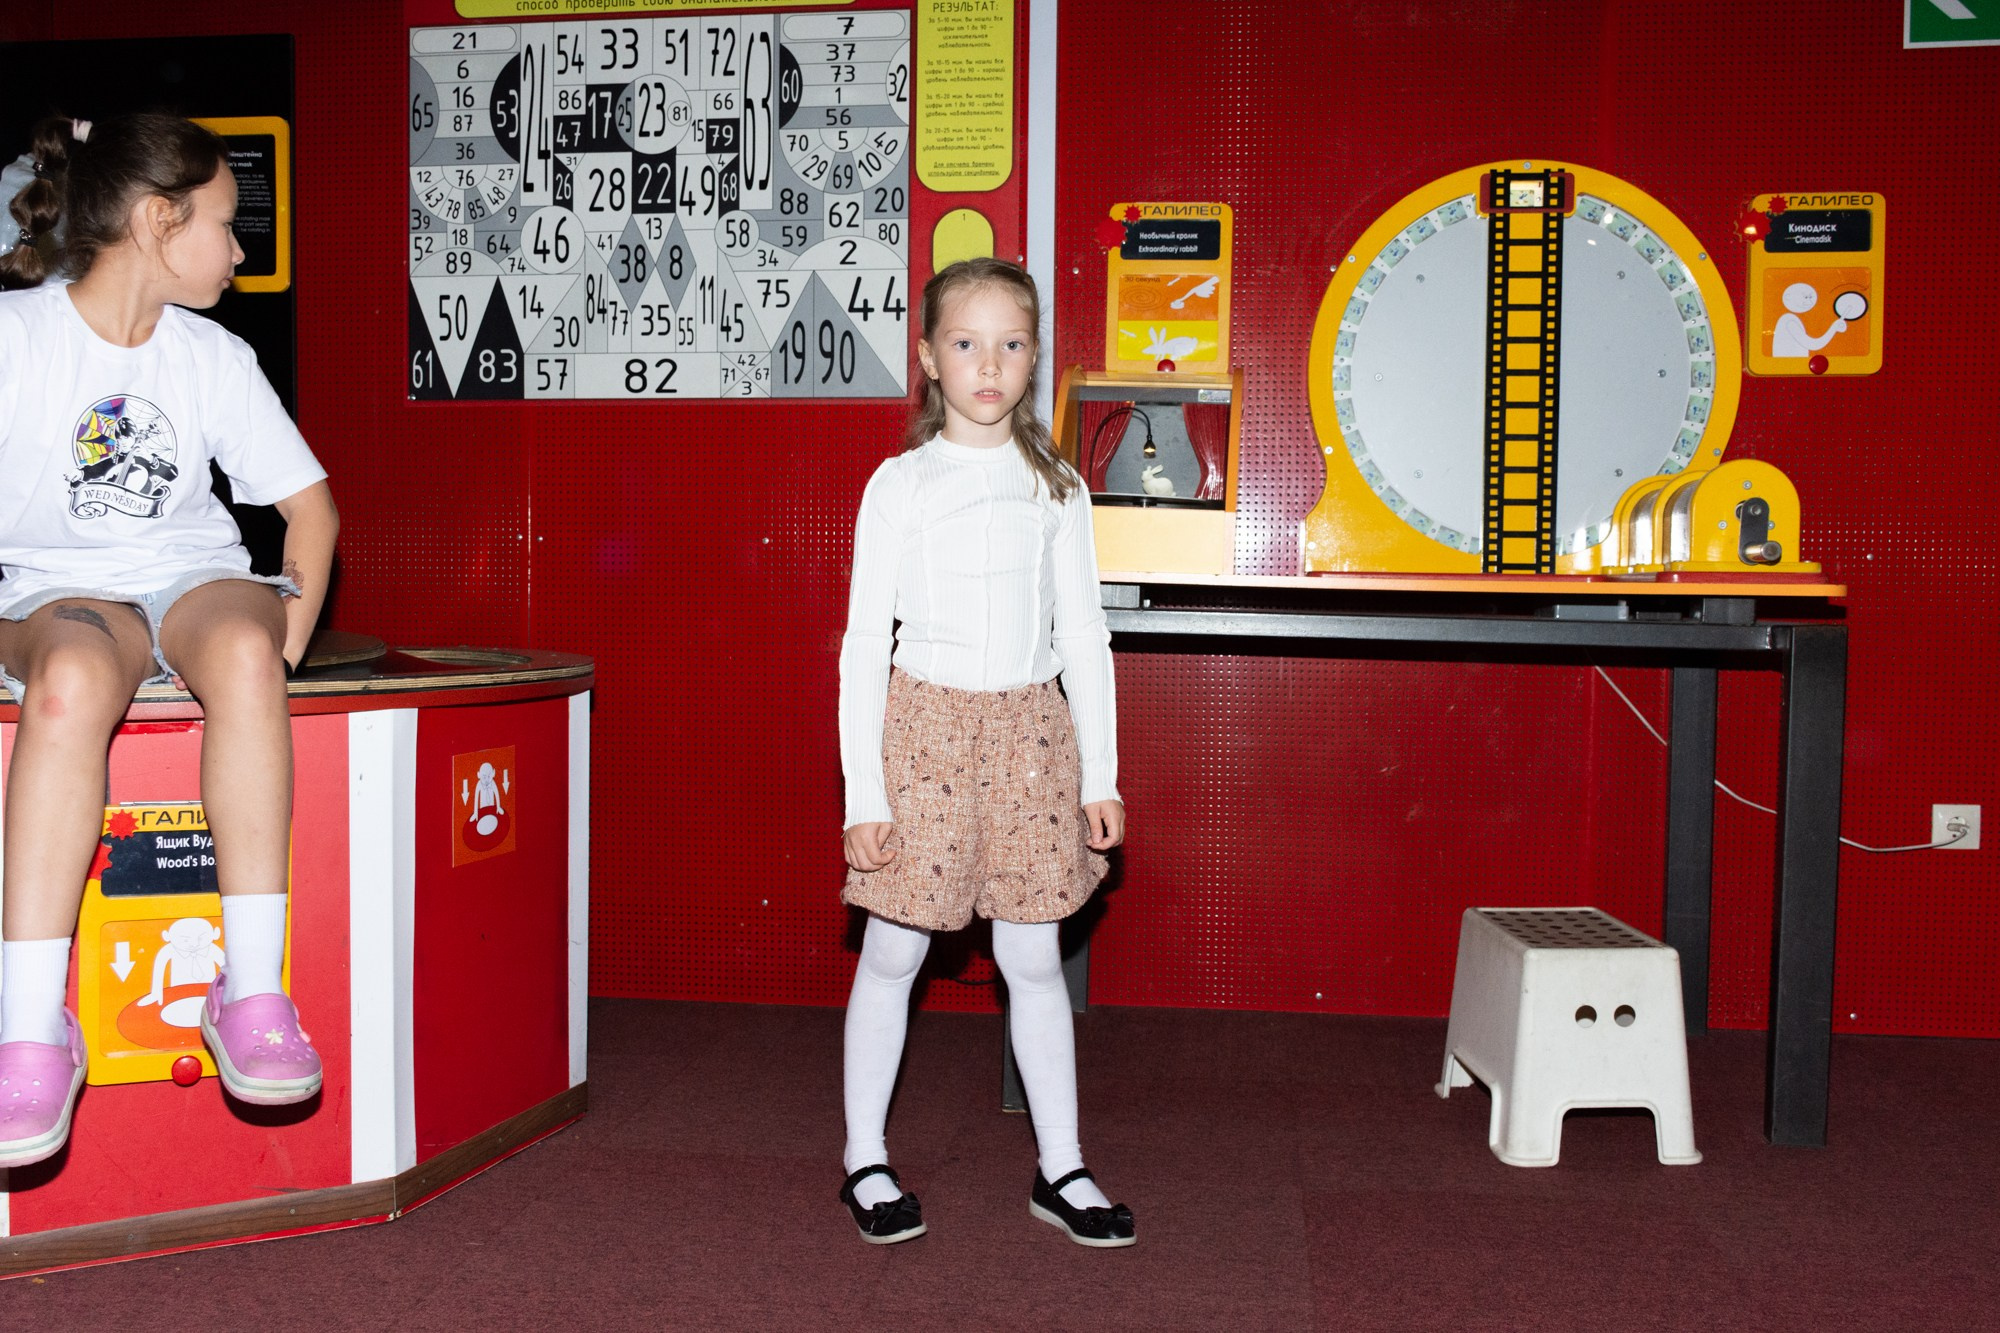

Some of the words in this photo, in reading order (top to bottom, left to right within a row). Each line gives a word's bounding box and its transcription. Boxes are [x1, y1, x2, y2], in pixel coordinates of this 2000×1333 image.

[837, 17, 854, 35] 7
[453, 32, 476, 49] 21
[601, 28, 638, 69] 33
[666, 28, 688, 76] 51
[707, 28, 735, 76] 72
[557, 34, 584, 74] 54
[826, 44, 856, 61] 37
[457, 60, 469, 78] 6
[831, 65, 855, 82] 73
[782, 69, 799, 103] 60
[889, 64, 907, 102] 32
[453, 86, 474, 108] 16
[559, 90, 581, 110] 86
[714, 93, 733, 110] 66
[835, 87, 841, 104] 1
[412, 94, 433, 132] 65
[496, 89, 519, 138] 53
[523, 43, 550, 192] 24
[588, 92, 612, 139] 17
[618, 98, 632, 132] 25
[638, 82, 666, 137] 23
[673, 106, 688, 121] 81
[744, 32, 771, 190] 63
[826, 109, 851, 125] 56
[453, 115, 473, 132] 87
[557, 122, 580, 147] 47
[692, 119, 704, 142] 15
[709, 125, 733, 146] 79
[787, 135, 808, 151] 70
[838, 131, 848, 150] 5
[874, 131, 898, 156] 40
[456, 143, 475, 159] 36
[566, 156, 577, 165] 31
[718, 154, 725, 166] 4
[498, 169, 514, 180] 27
[802, 154, 828, 181] 29
[833, 164, 853, 189] 69
[858, 152, 882, 178] 10
[417, 171, 431, 183] 12
[456, 170, 474, 186] 76
[556, 173, 571, 200] 26
[637, 162, 671, 204] 22
[722, 172, 736, 201] 68
[425, 187, 443, 208] 43
[487, 186, 505, 206] 48
[589, 168, 625, 212] 28
[679, 165, 715, 216] 49
[780, 188, 808, 214] 88
[874, 187, 904, 213] 20
[1789, 195, 1873, 206] ГАЛИЛЕО
[412, 209, 430, 230] 39
[447, 200, 461, 219] 78
[468, 199, 485, 220] 85
[508, 207, 516, 223] 9
[829, 201, 859, 228] 62
[1143, 206, 1221, 215] ГАЛИЛЕО
[452, 229, 467, 245] 18
[533, 216, 569, 263] 46
[646, 218, 662, 240] 13
[727, 219, 749, 248] 58
[782, 225, 807, 247] 59
[878, 223, 899, 245] 80
[1789, 224, 1836, 232] Кинодиск
[415, 237, 433, 261] 52
[487, 235, 511, 254] 64
[598, 234, 612, 250] 41
[840, 240, 857, 264] 2
[446, 252, 471, 274] 89
[508, 258, 526, 272] 74
[619, 244, 646, 283] 38
[670, 245, 682, 280] 8
[757, 250, 778, 267] 34
[519, 285, 544, 319] 14
[586, 274, 607, 324] 84
[700, 275, 714, 324] 11
[757, 279, 790, 308] 75
[848, 276, 906, 321] 44
[439, 295, 467, 341] 50
[609, 301, 628, 335] 77
[641, 304, 670, 336] 35
[720, 289, 743, 342] 45
[554, 316, 580, 347] 30
[679, 317, 693, 346] 55
[412, 350, 433, 388] 61
[479, 349, 517, 382] 83
[738, 355, 756, 366] 42
[538, 359, 567, 390] 57
[625, 358, 677, 393] 82
[722, 369, 735, 384] 71
[755, 368, 770, 380] 67
[742, 382, 752, 395] 3
[84, 489, 148, 512] WEDNESDAY
[142, 811, 206, 825] ГАЛИ
[156, 836, 190, 849] Ящик
[193, 834, 213, 848] Вуд
[157, 857, 198, 868] Wood's
[201, 855, 216, 866] Bo
